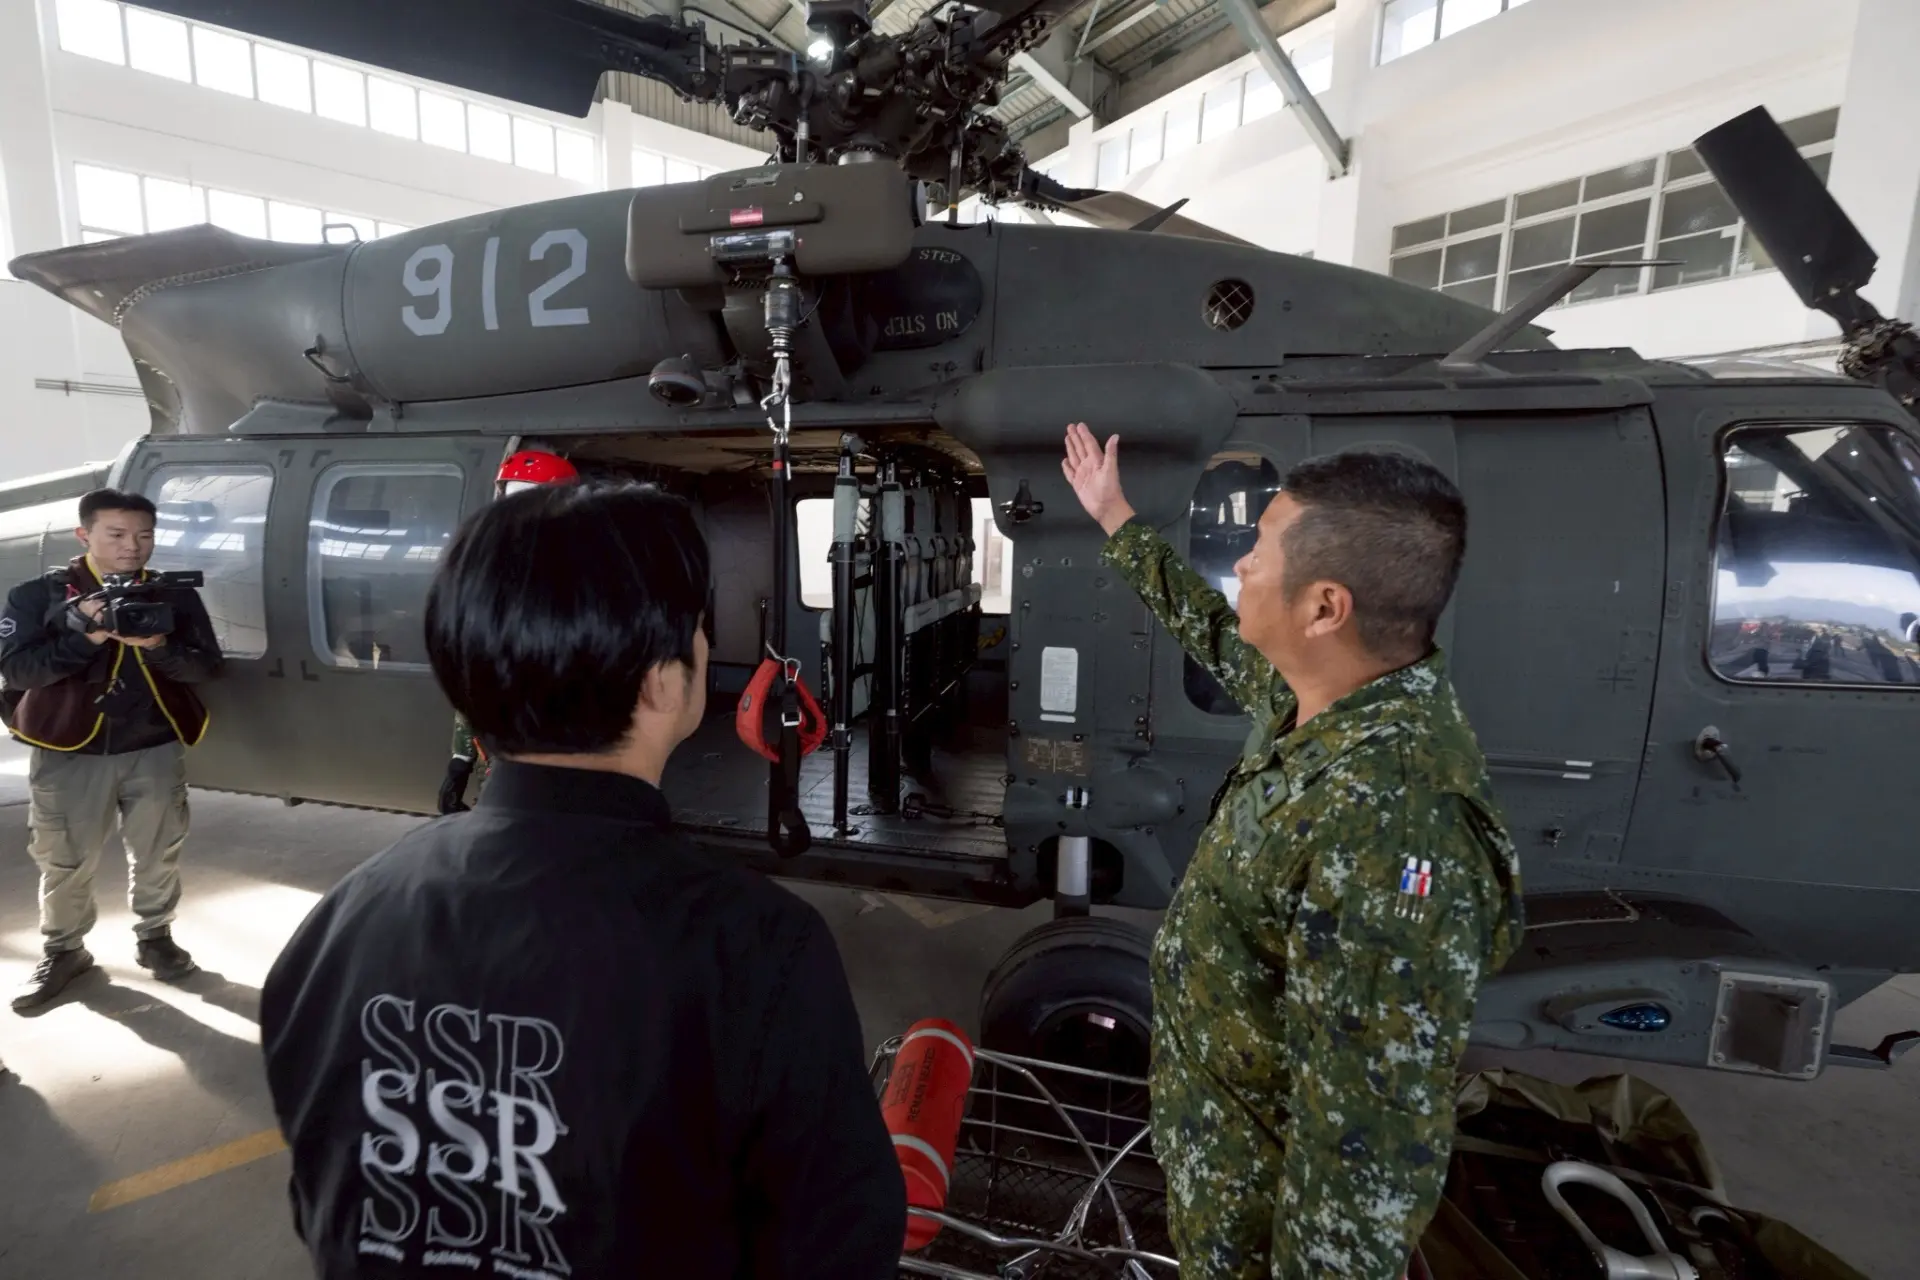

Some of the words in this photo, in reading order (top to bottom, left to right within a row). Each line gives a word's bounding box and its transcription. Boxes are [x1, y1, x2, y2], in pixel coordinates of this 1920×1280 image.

[919, 248, 963, 264] STEP
[402, 228, 590, 337] 912
[883, 314, 926, 336] STEP
[936, 310, 959, 331] NO
[360, 993, 569, 1136] SSR
[907, 1081, 927, 1121] REMAIN
[360, 1067, 567, 1214] SSR
